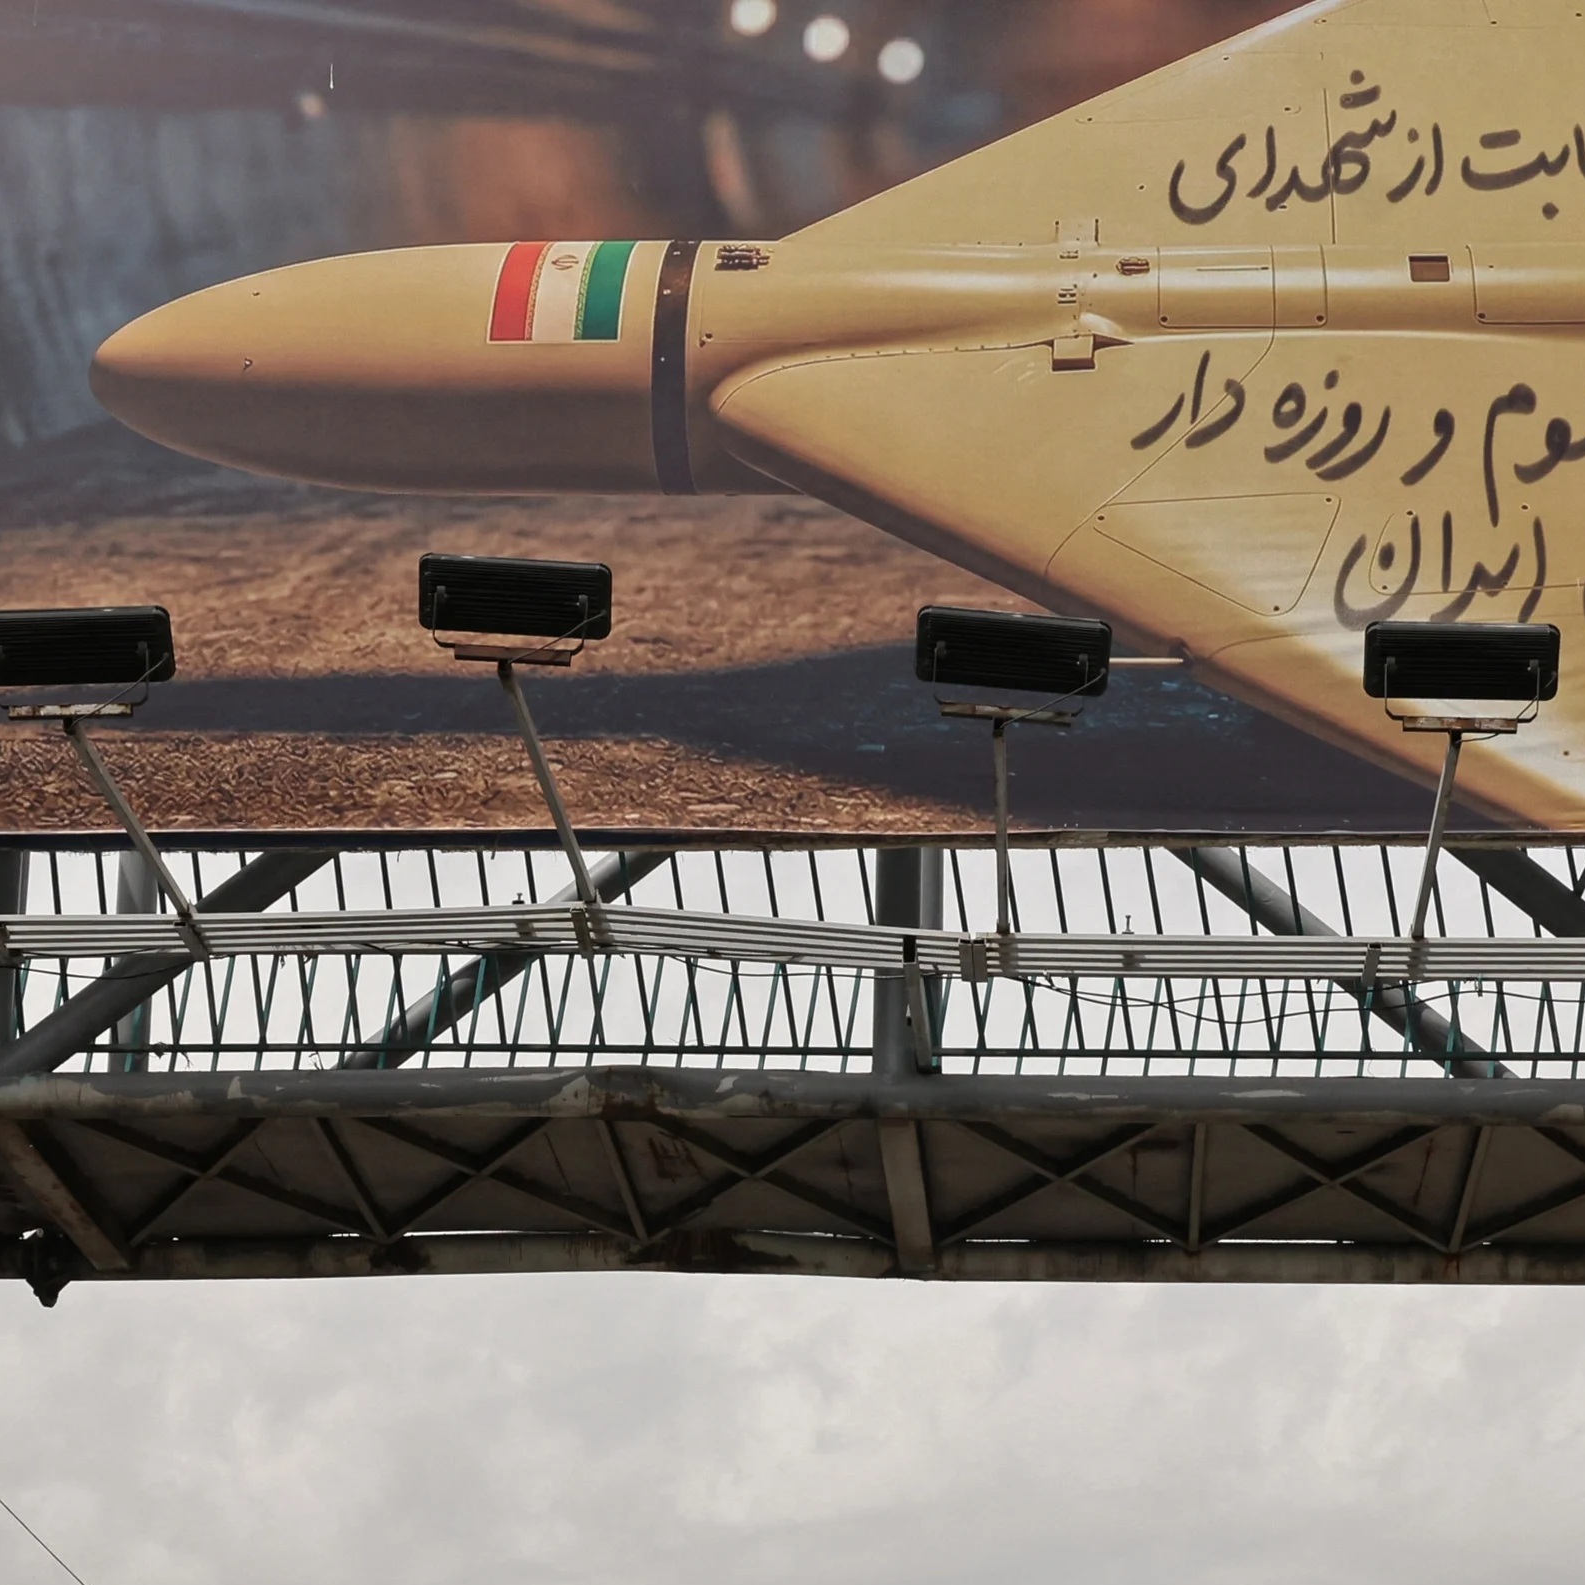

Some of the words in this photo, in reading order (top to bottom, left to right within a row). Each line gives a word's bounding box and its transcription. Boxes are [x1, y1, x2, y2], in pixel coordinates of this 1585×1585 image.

[1168, 69, 1398, 225] شهدای
[1388, 123, 1444, 203] از
[1130, 350, 1246, 451] دار
[1263, 369, 1391, 483] روزه
[1399, 407, 1456, 486] و
[1334, 512, 1546, 630] ایران
